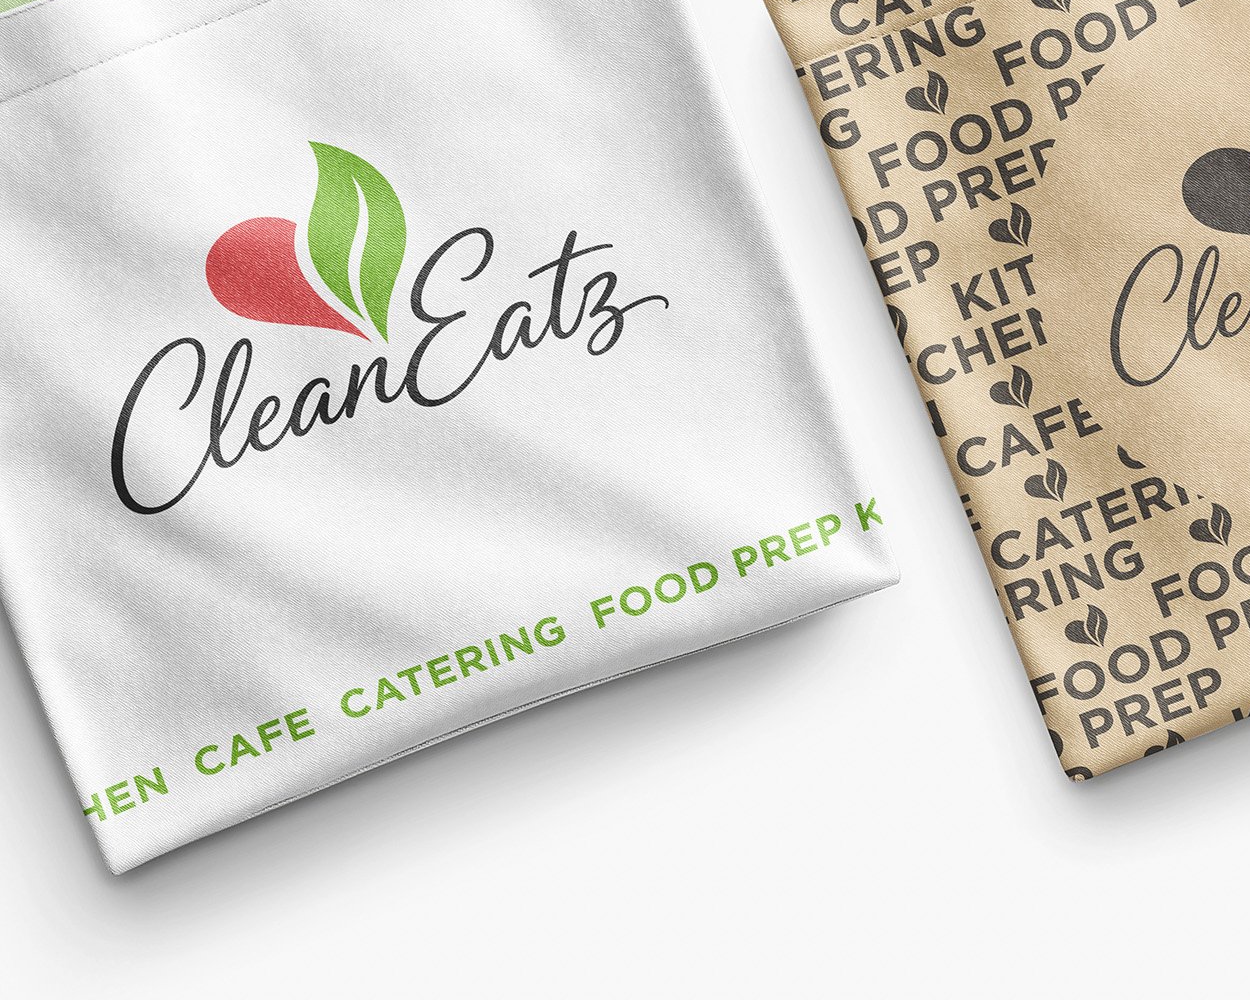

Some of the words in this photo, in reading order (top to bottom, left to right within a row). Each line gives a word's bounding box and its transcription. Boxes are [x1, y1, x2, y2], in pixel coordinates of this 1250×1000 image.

[795, 5, 987, 102] ERING
[868, 98, 1034, 189] FOOD
[111, 227, 670, 515] CleanEatz
[956, 397, 1104, 477] CAFE
[995, 540, 1146, 622] RING
[193, 707, 316, 776] CAFE
[339, 615, 567, 719] CATERING
[589, 561, 719, 630] FOOD
[731, 513, 842, 578] PREP
[1030, 629, 1192, 716] FOOD
[1078, 667, 1223, 749] PREP
